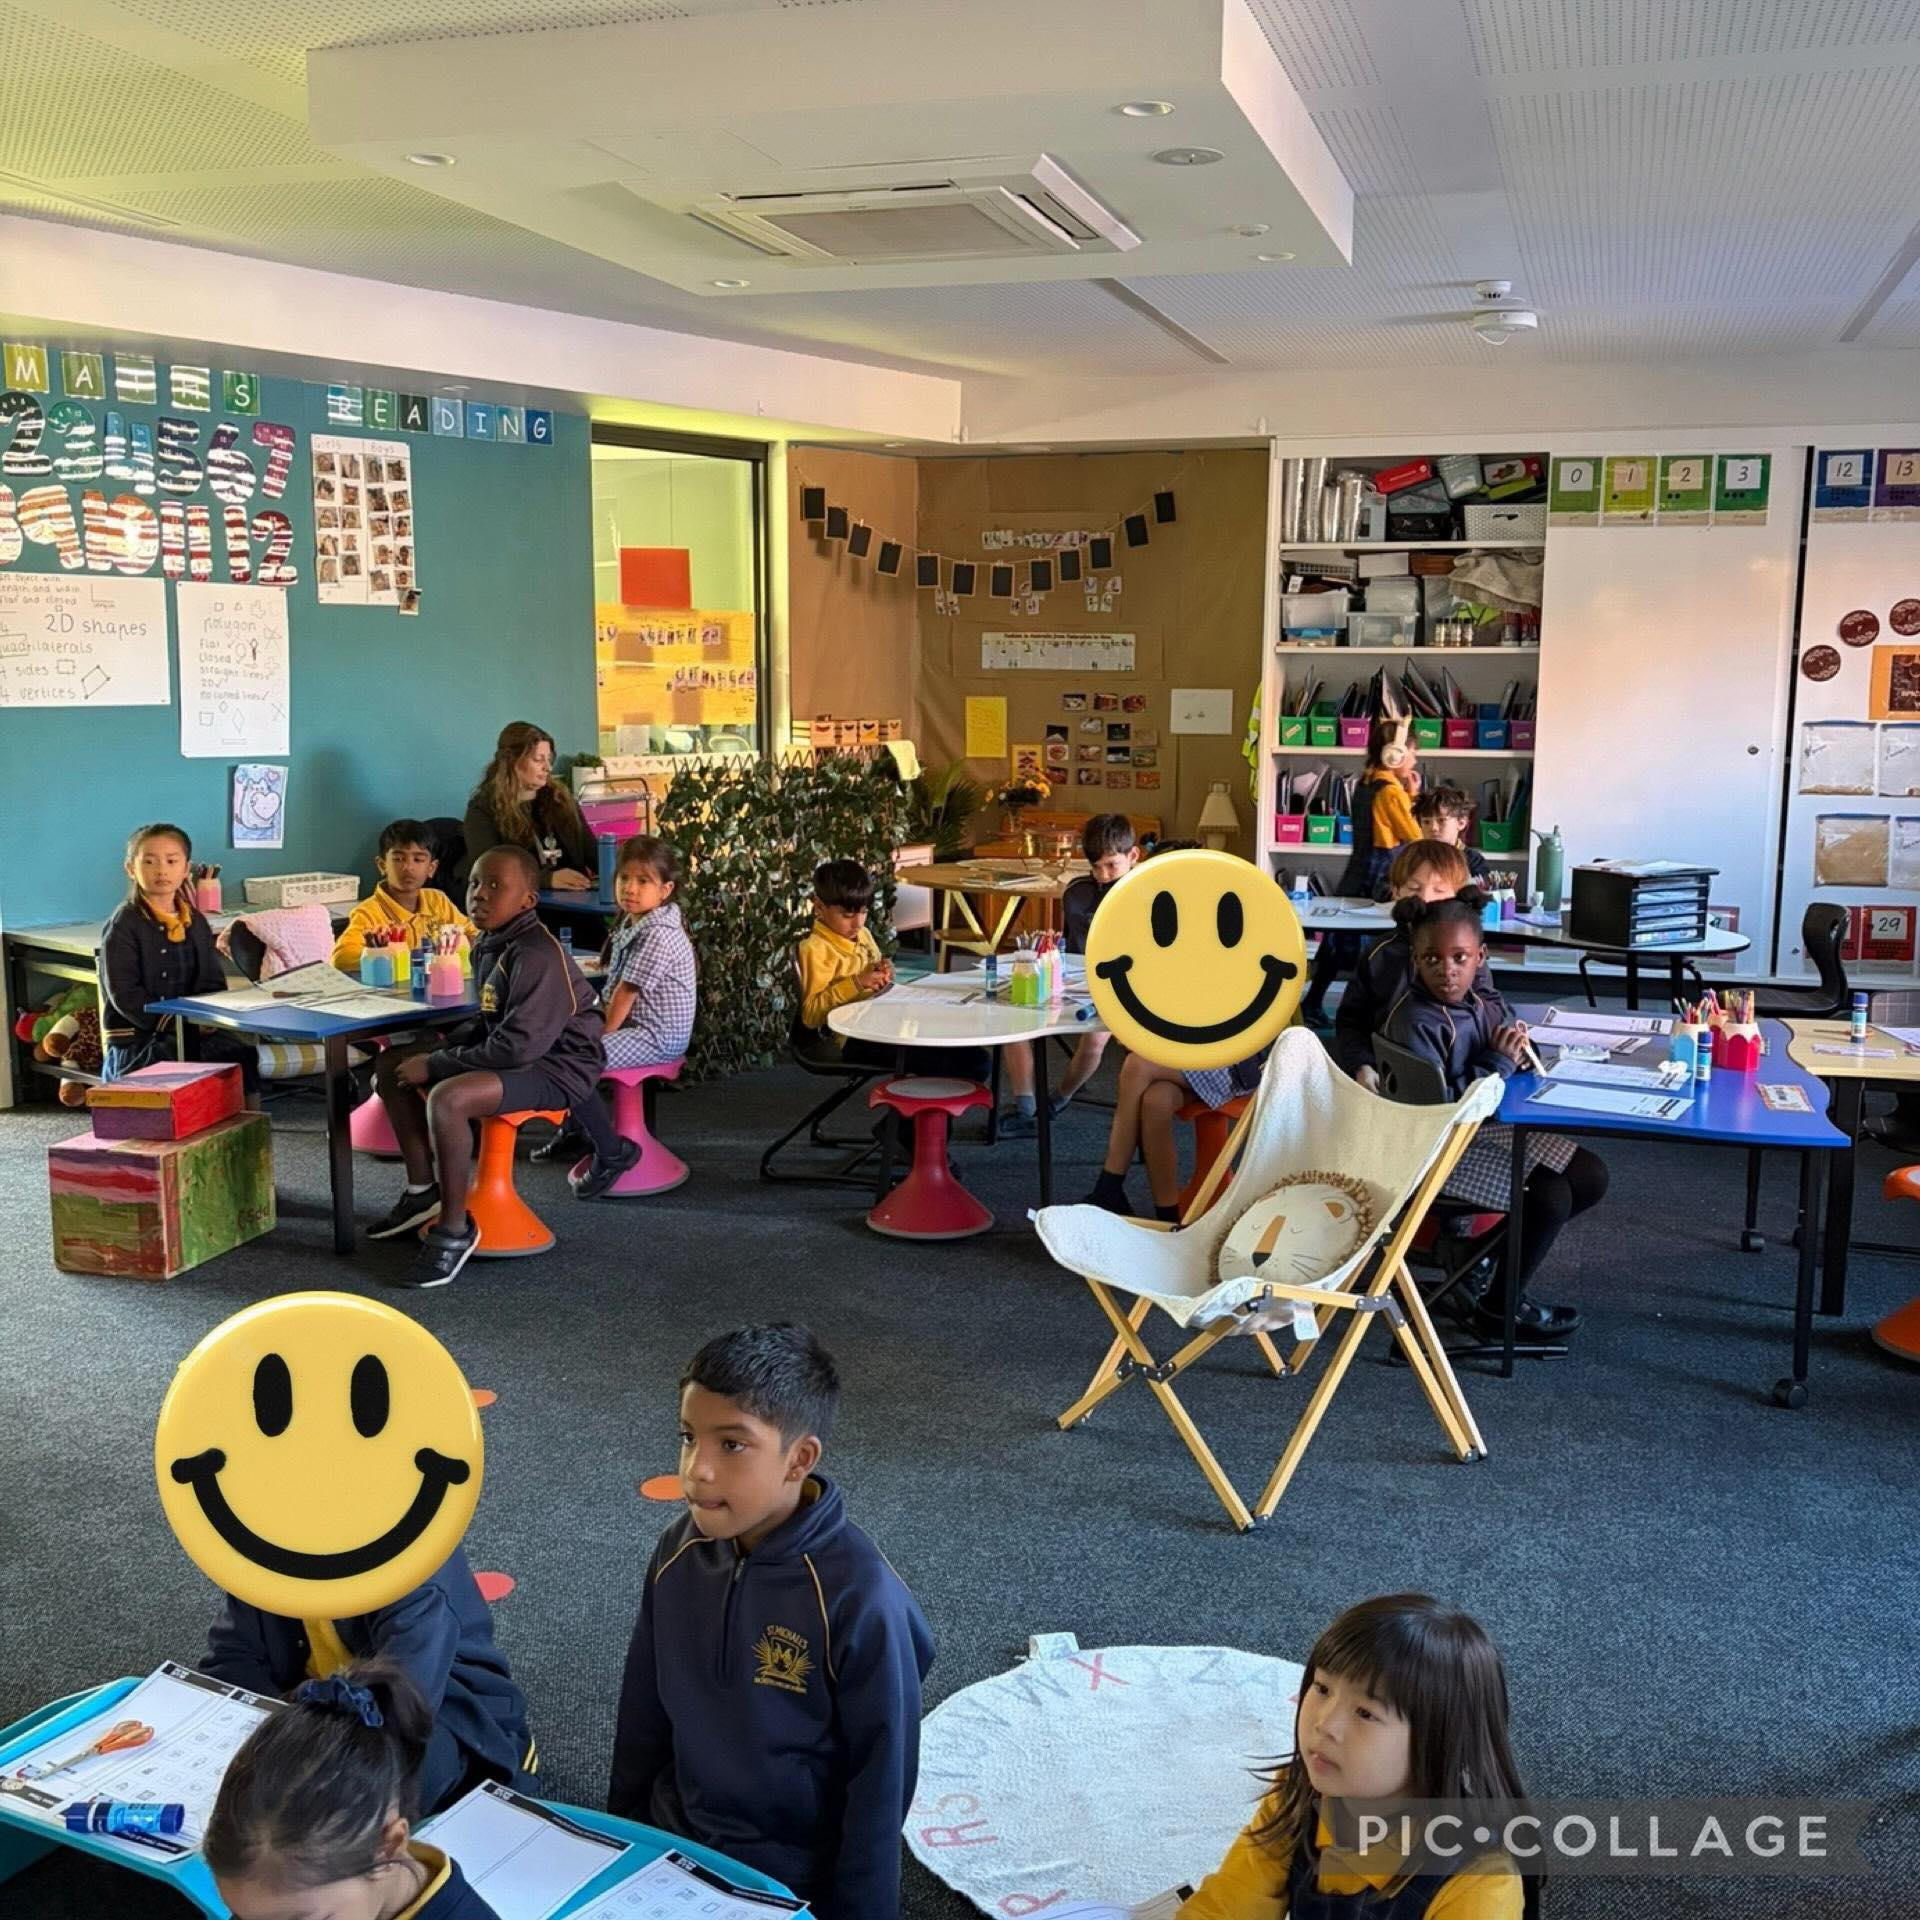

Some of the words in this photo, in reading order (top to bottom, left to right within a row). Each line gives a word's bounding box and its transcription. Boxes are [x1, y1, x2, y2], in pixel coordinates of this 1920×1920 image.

[339, 395, 547, 439] READING
[157, 416, 203, 497] 5
[207, 421, 257, 503] 6
[253, 420, 296, 499] 7
[1895, 460, 1914, 476] 13
[1570, 466, 1583, 484] 0
[1626, 466, 1634, 482] 1
[1679, 466, 1692, 482] 2
[1738, 465, 1750, 482] 3
[1836, 461, 1854, 478] 12
[44, 613, 75, 633] 2D
[82, 618, 147, 641] shapes
[0, 640, 94, 654] uadrilaterals
[19, 687, 77, 700] vertices
[1878, 916, 1901, 932] 29
[1066, 1652, 1132, 1692] X
